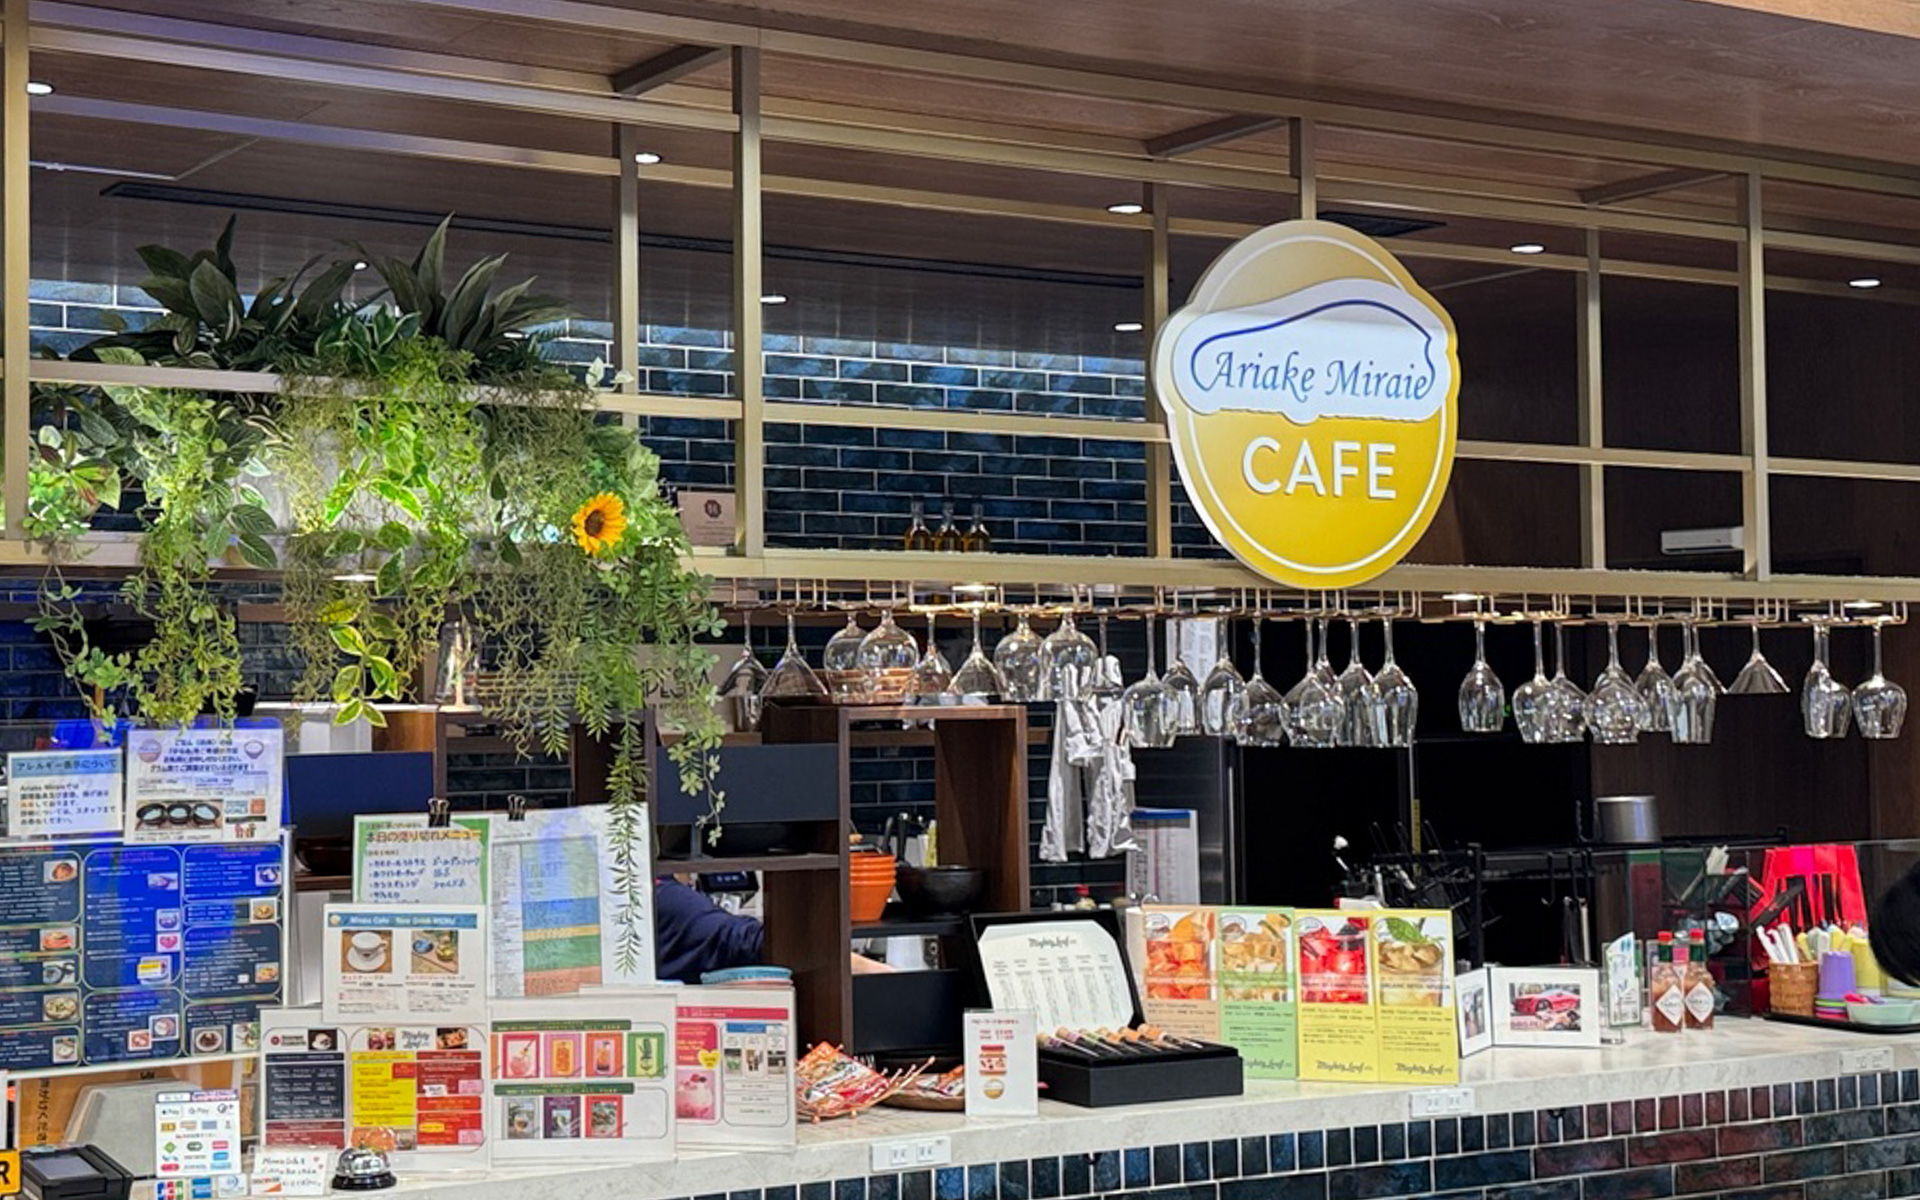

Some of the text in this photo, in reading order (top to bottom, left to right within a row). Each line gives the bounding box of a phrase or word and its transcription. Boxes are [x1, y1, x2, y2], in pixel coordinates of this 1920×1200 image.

[1210, 350, 1429, 403] Ariake Miraie
[1242, 435, 1397, 500] CAFE
[17, 758, 117, 771] アレルギー表示について
